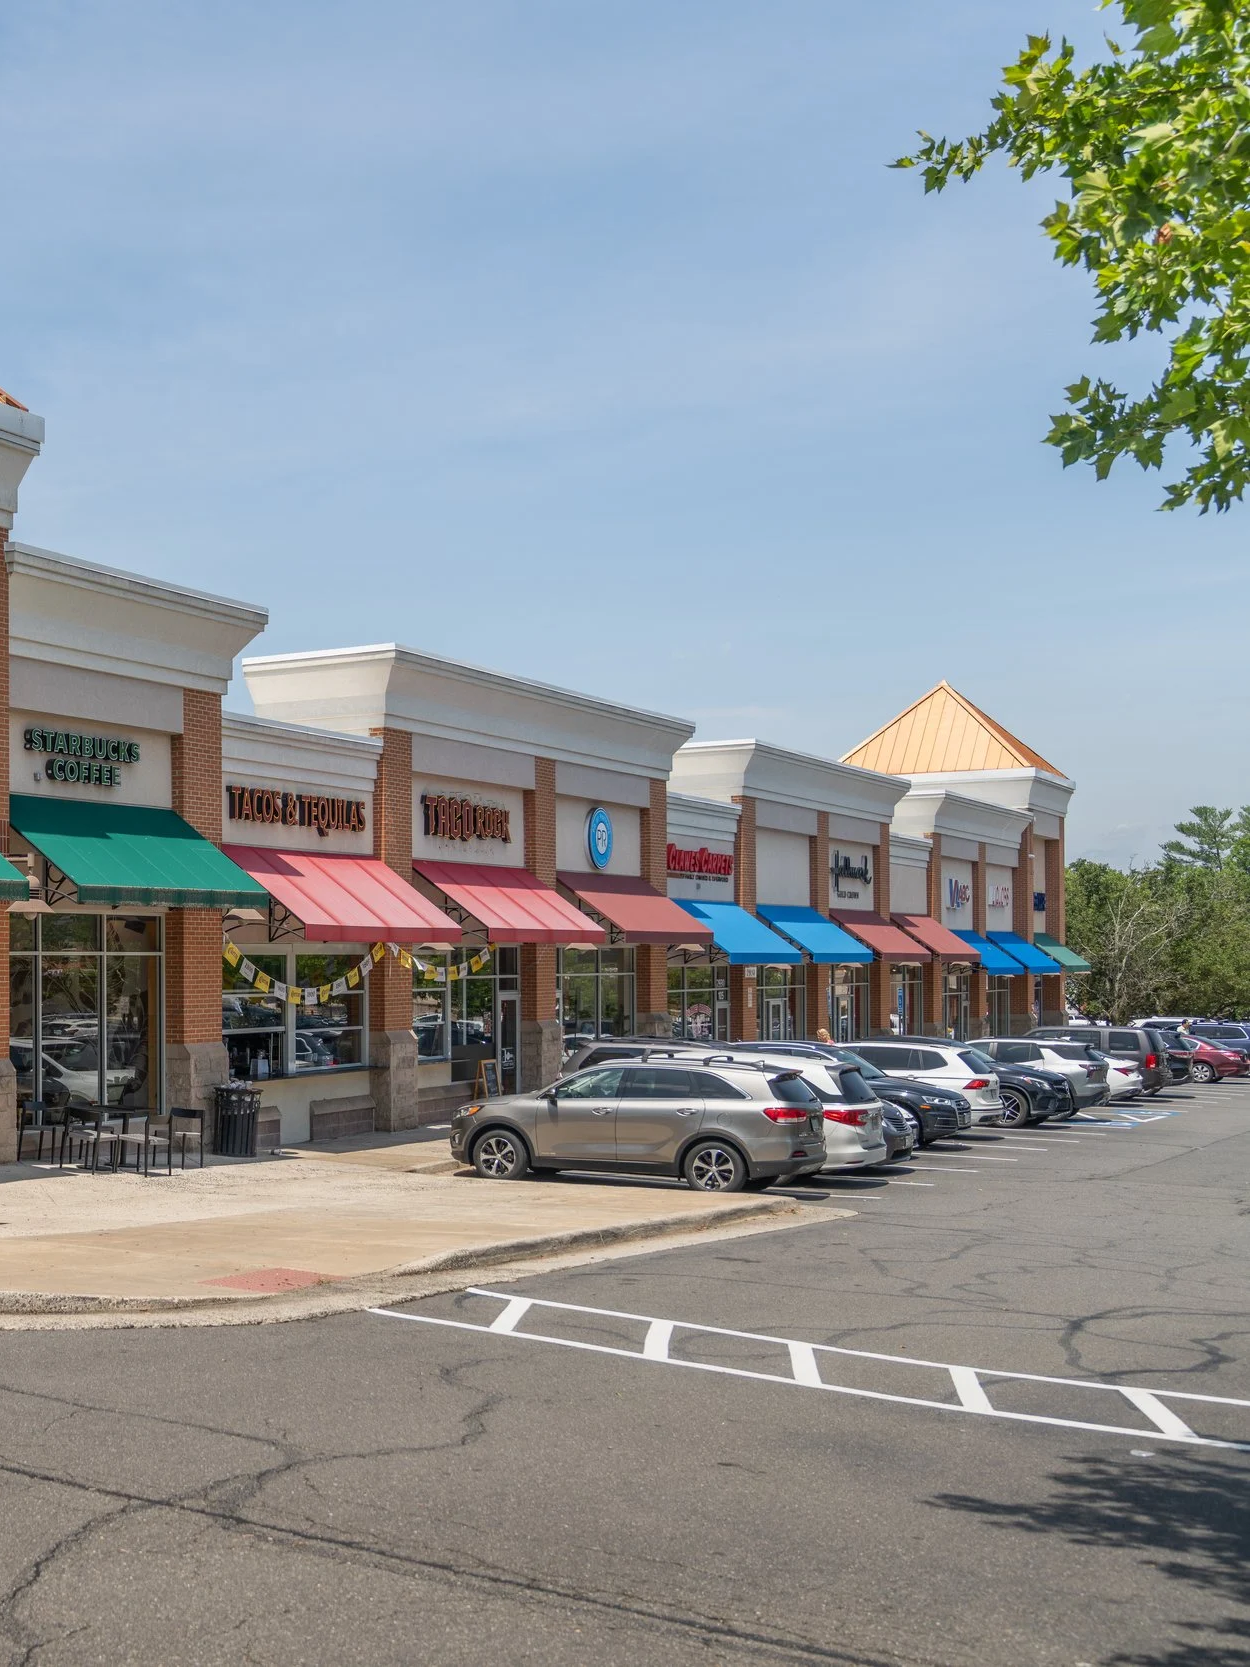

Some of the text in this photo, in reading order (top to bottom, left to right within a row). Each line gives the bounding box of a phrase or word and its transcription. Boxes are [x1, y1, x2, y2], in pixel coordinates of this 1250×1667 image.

[29, 728, 140, 763] STARBUCKS
[50, 758, 121, 787] COFFEE
[229, 785, 366, 837] TACOS & TEQUILAS
[424, 795, 511, 843] TACO ROCK
[668, 845, 734, 875] CLAWES CARPETS
[831, 850, 872, 892] Hallmark
